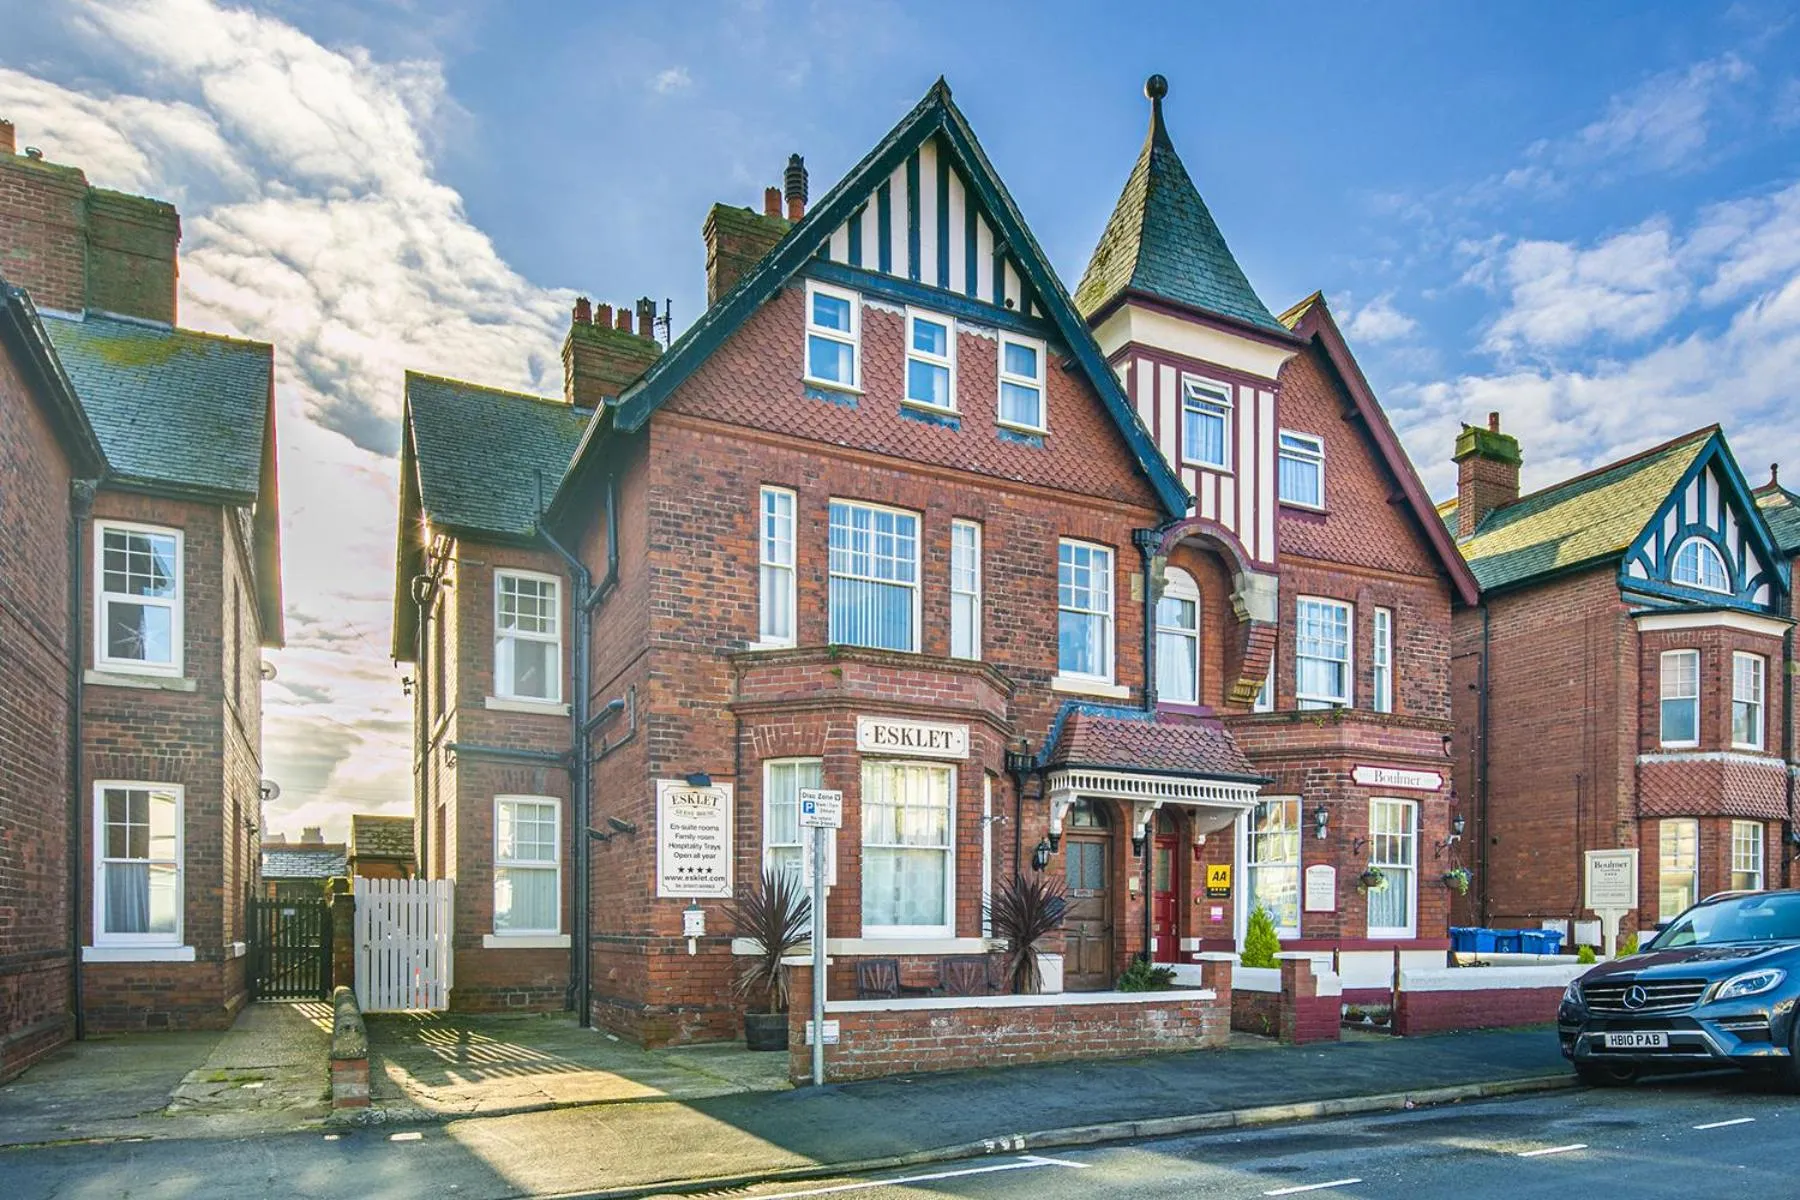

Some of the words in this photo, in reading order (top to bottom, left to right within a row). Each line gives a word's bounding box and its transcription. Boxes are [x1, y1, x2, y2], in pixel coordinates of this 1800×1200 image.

[873, 725, 953, 749] ESKLET
[671, 794, 718, 807] ESKLET
[675, 833, 696, 841] Family
[673, 851, 692, 859] Open
[664, 874, 726, 882] www.esklet.com
[1212, 871, 1227, 882] AA
[1610, 1034, 1633, 1046] HB10
[1636, 1034, 1661, 1046] PAB
